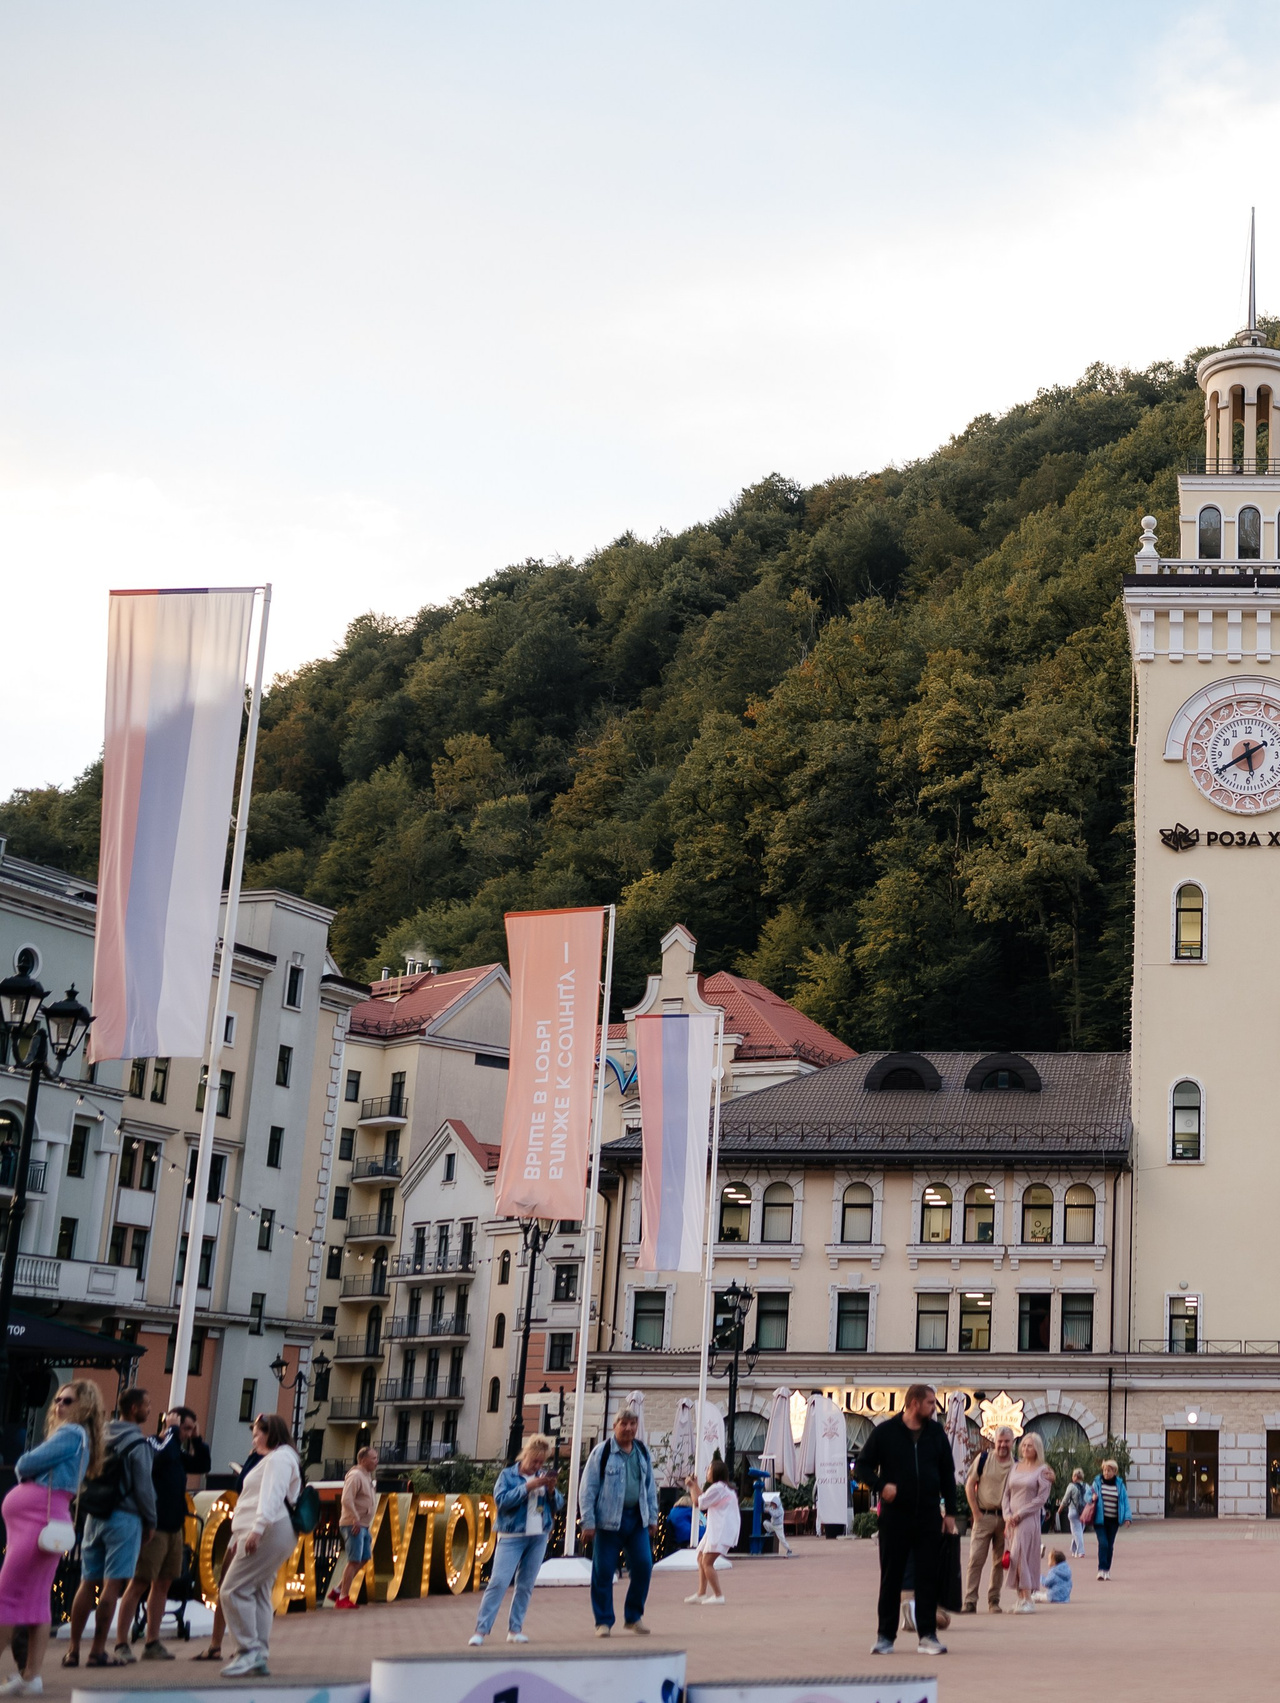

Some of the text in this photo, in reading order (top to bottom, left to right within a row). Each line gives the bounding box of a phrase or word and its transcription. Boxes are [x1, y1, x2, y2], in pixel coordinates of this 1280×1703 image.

[1232, 730, 1238, 738] 11
[1245, 726, 1252, 735] 12
[1223, 738, 1230, 746] 10
[1270, 738, 1275, 746] 2
[1218, 751, 1223, 759] 9
[1275, 751, 1279, 759] 3
[1270, 765, 1274, 773] 4
[1246, 777, 1251, 785] 6
[1207, 831, 1262, 847] РОЗА
[7, 1325, 26, 1336] ТОР
[827, 1391, 972, 1412] UCIN
